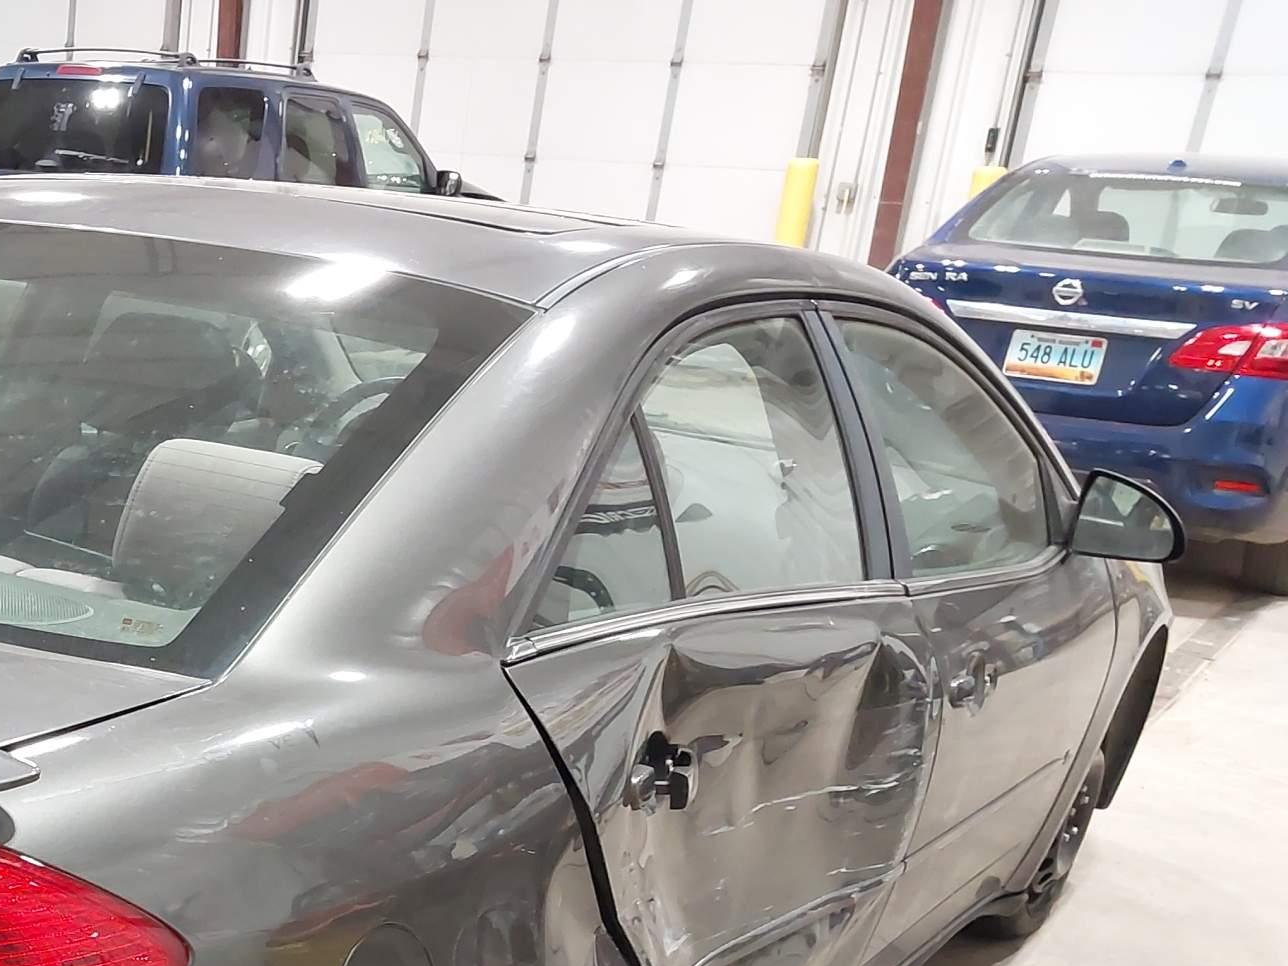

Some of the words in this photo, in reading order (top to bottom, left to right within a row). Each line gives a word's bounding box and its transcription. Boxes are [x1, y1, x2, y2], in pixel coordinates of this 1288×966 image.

[1231, 298, 1260, 311] SV
[1016, 342, 1053, 365] 548
[1056, 347, 1095, 369] ALU
